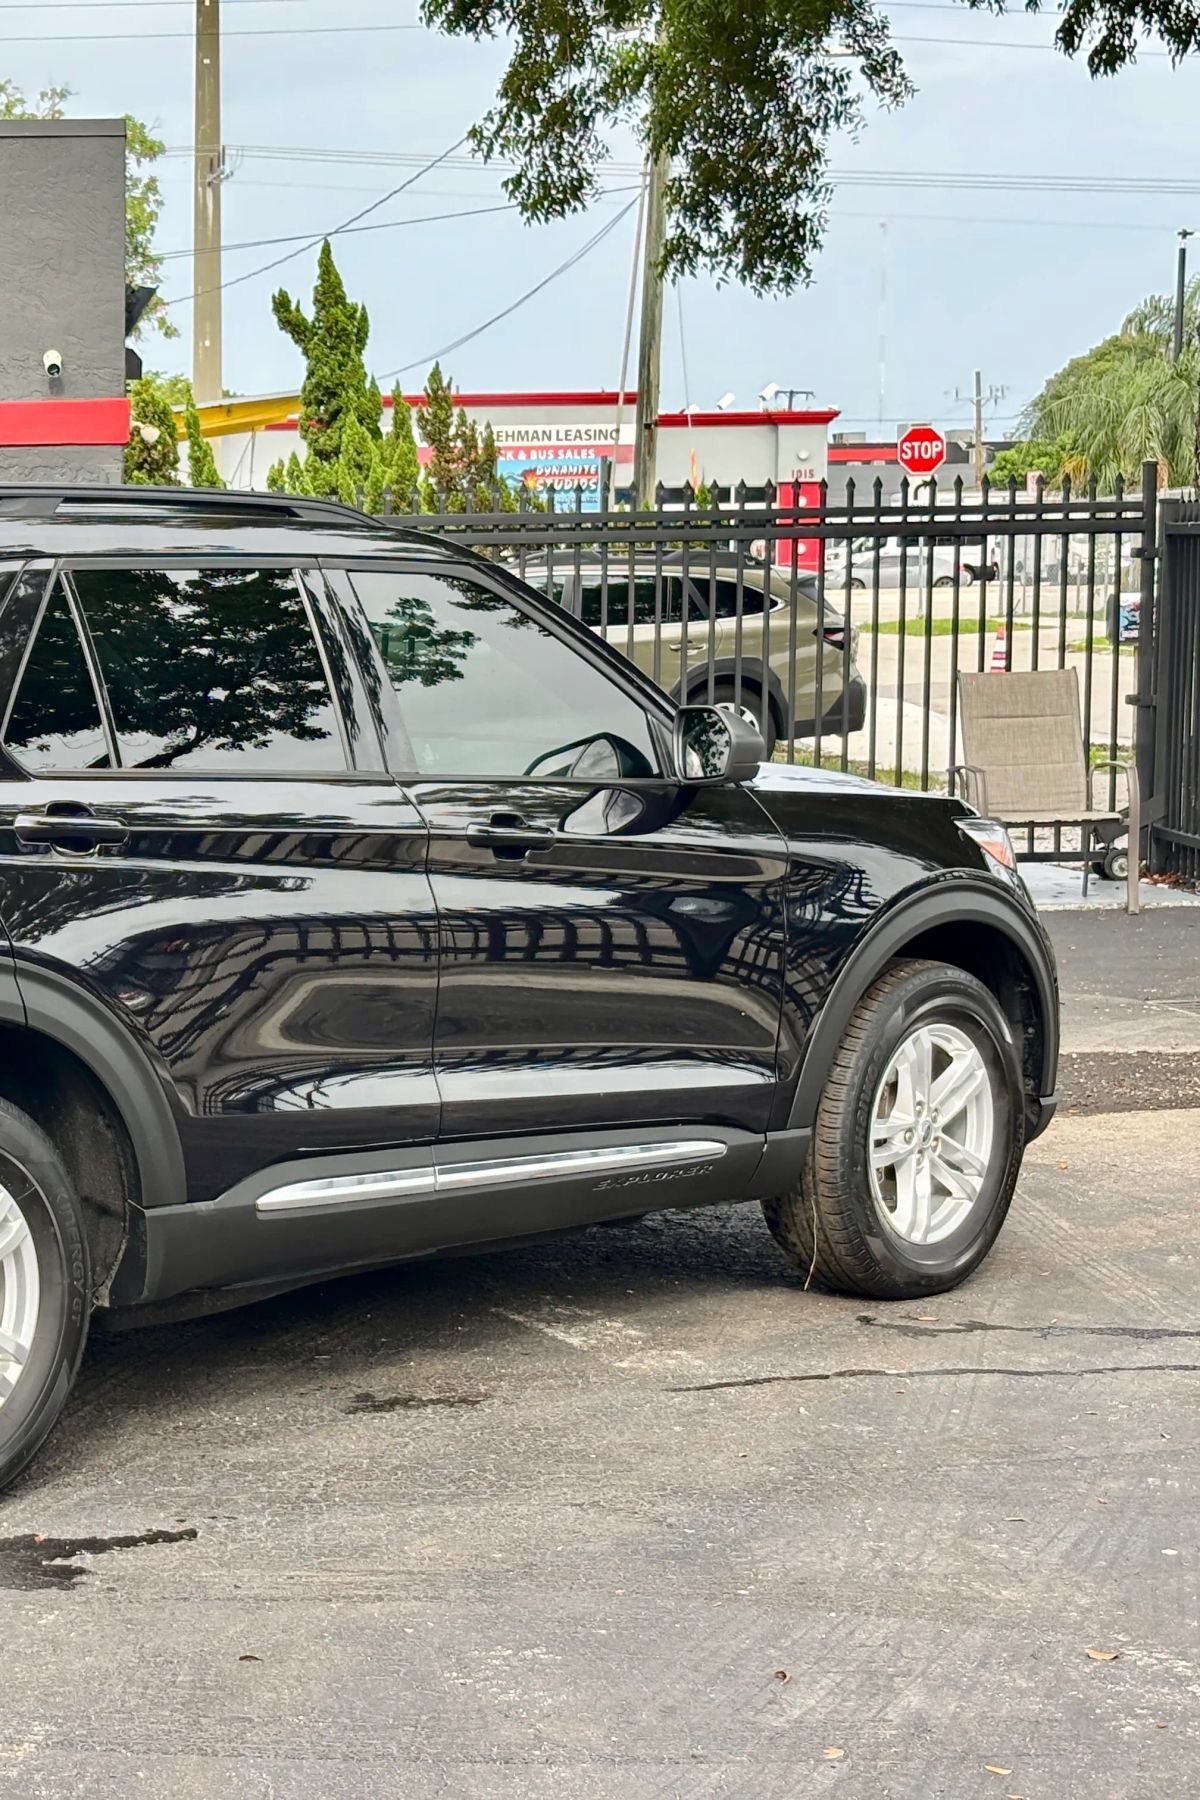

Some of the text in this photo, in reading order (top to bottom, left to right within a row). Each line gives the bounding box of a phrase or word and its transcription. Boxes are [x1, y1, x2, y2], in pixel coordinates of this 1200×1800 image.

[493, 429, 552, 443] EHMAN
[530, 449, 554, 460] BUS
[557, 448, 595, 460] SALES
[901, 441, 943, 459] STOP
[535, 464, 598, 477] DYNAMITE
[535, 478, 597, 491] STUDIOS
[591, 1165, 713, 1191] EXPLORER
